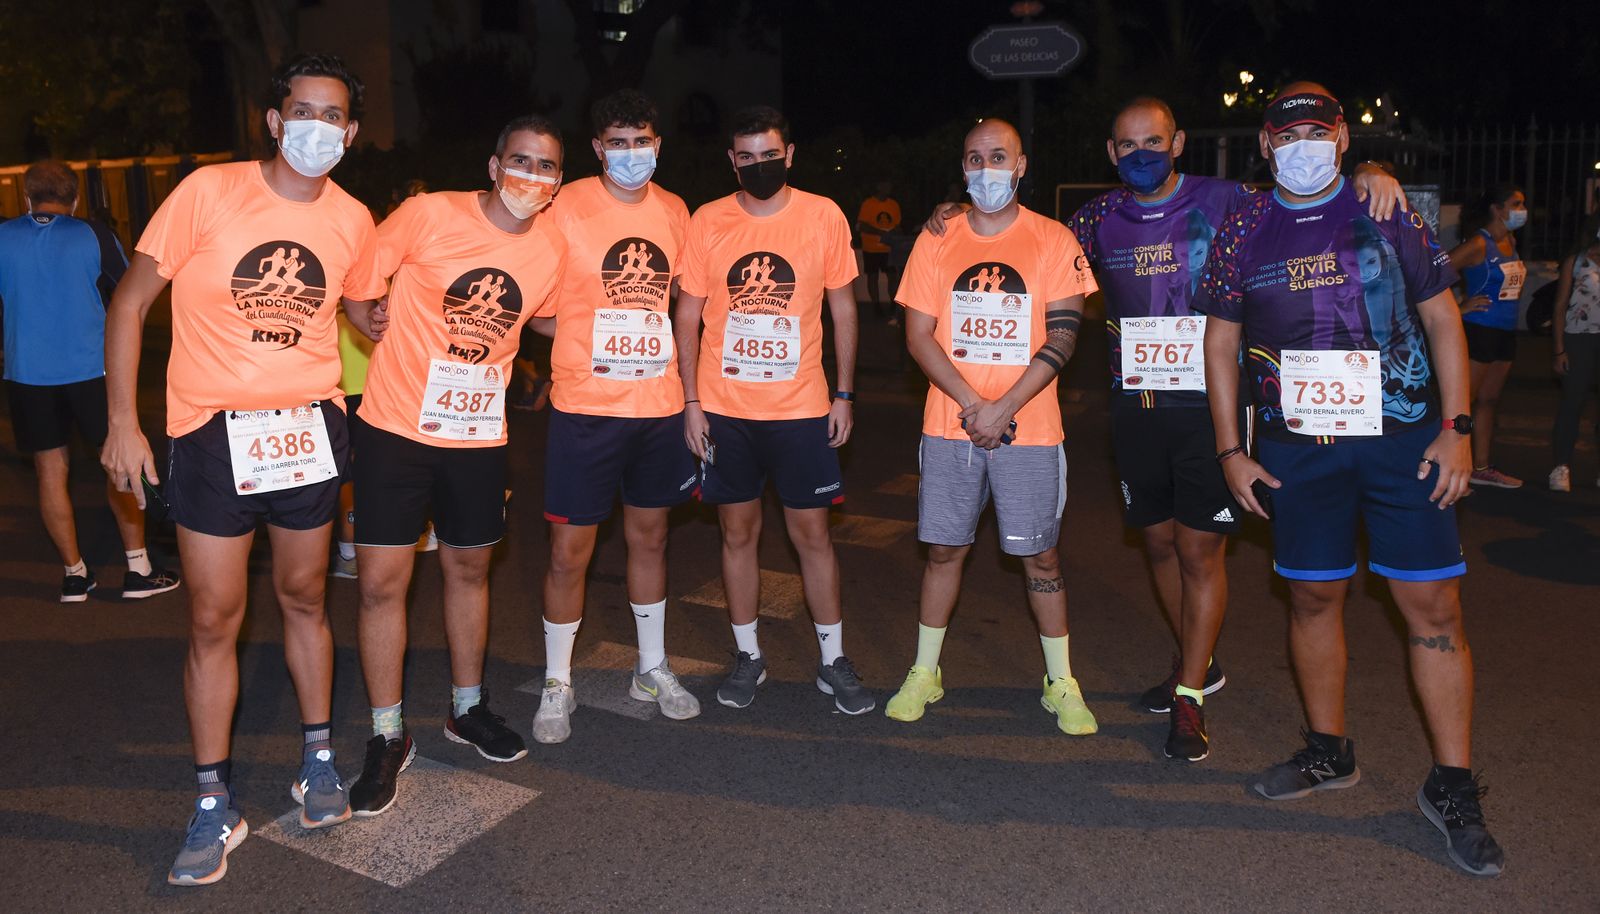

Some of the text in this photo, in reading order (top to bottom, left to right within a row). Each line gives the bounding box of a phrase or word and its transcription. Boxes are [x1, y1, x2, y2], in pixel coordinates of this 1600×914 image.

[1010, 37, 1038, 48] PASEO
[991, 51, 1059, 63] DE LAS DELICIAS
[1134, 243, 1173, 253] CONSIGUE
[1135, 251, 1173, 264] VIVIR
[1287, 252, 1337, 266] CONSIGUE
[1287, 260, 1337, 277] VIVIR
[606, 286, 664, 300] LA NOCTURNA
[613, 295, 658, 307] del Guadalquivir
[236, 298, 316, 319] LA NOCTURNA
[729, 298, 788, 311] LA NOCTURNA
[245, 309, 305, 326] del Guadalquivir
[445, 316, 507, 339] LA NOCTURNA
[448, 326, 497, 345] del Guadalquivir
[960, 317, 1018, 340] 4852
[447, 343, 482, 365] KH7
[604, 335, 661, 357] 4849
[733, 338, 788, 360] 4853
[1134, 343, 1194, 364] 5767
[436, 389, 496, 413] 4387
[422, 410, 438, 418] JUAN
[438, 412, 459, 421] MANUEL
[1294, 407, 1312, 415] DAVID
[247, 431, 316, 461] 4386
[252, 457, 317, 473] JUAN BARRERA TORO
